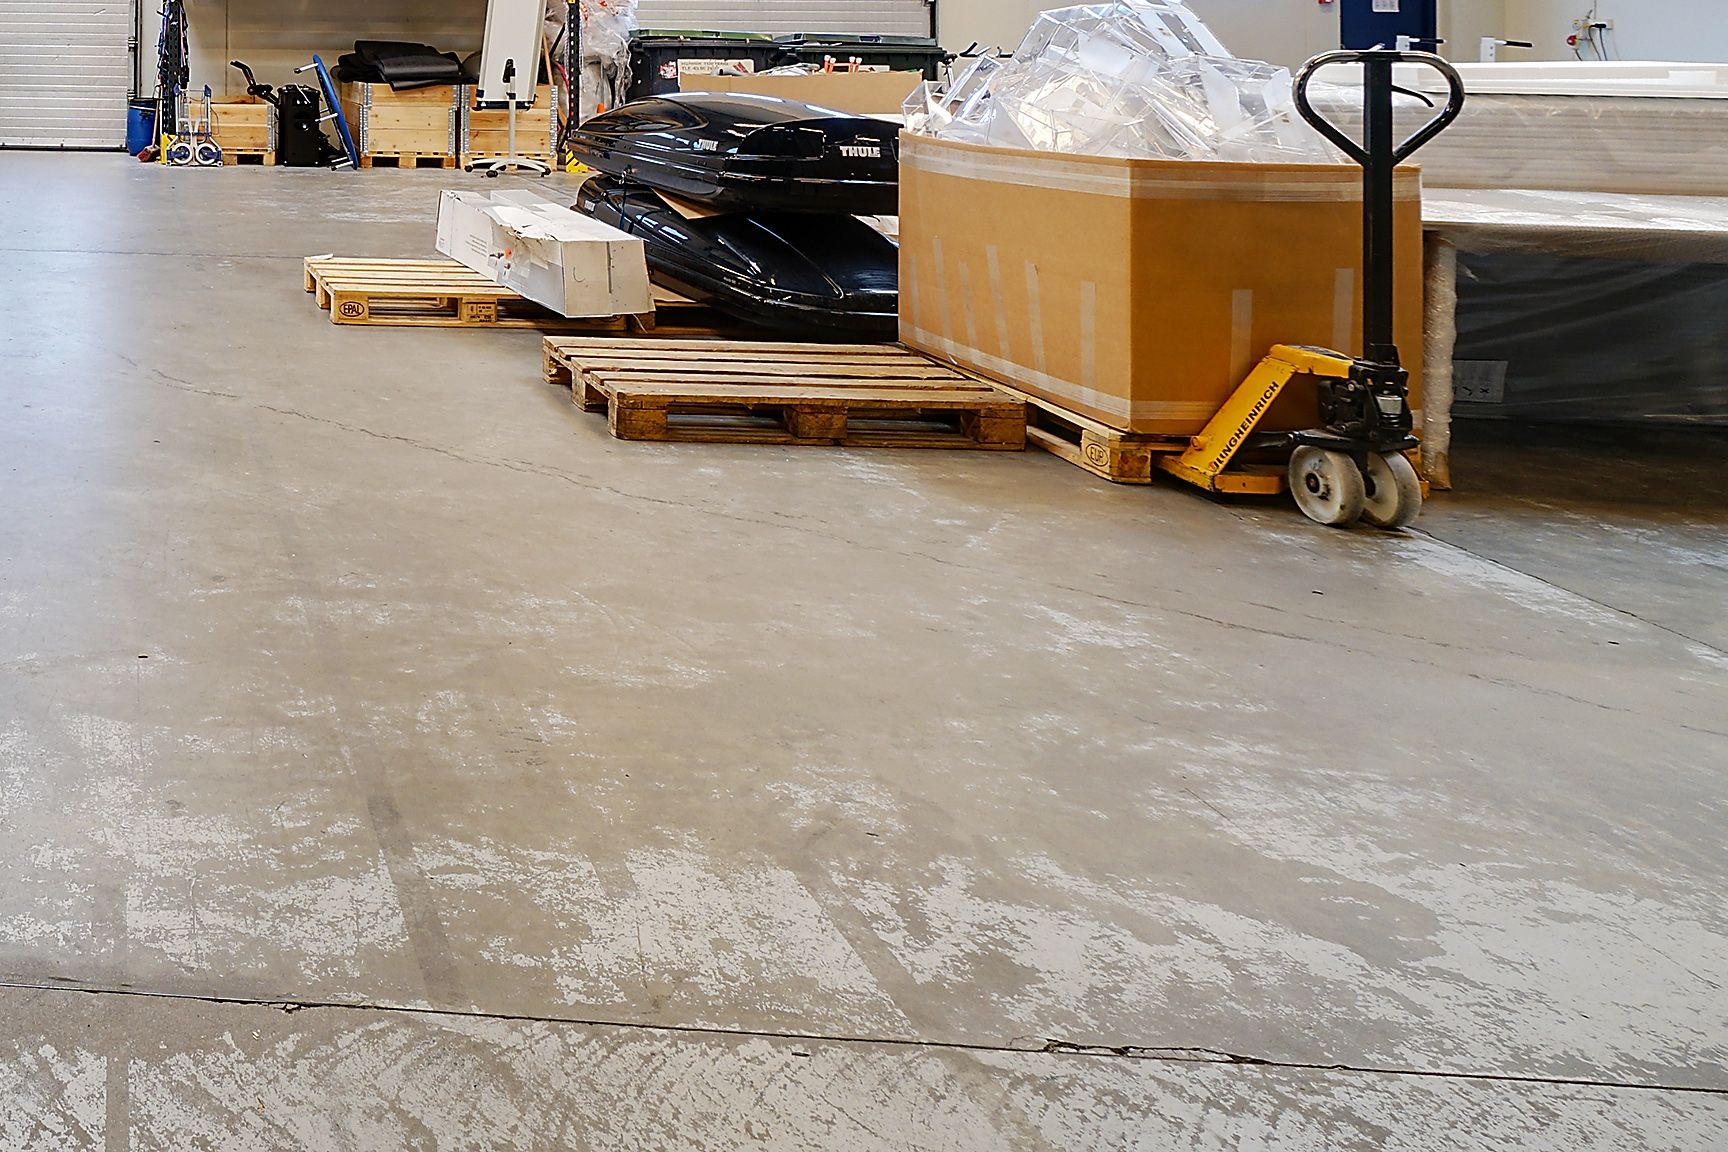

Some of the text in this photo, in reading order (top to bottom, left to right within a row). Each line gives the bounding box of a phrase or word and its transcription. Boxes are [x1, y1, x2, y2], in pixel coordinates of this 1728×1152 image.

[698, 138, 719, 152] THULE
[839, 146, 881, 158] THULE
[343, 303, 361, 315] EPAL
